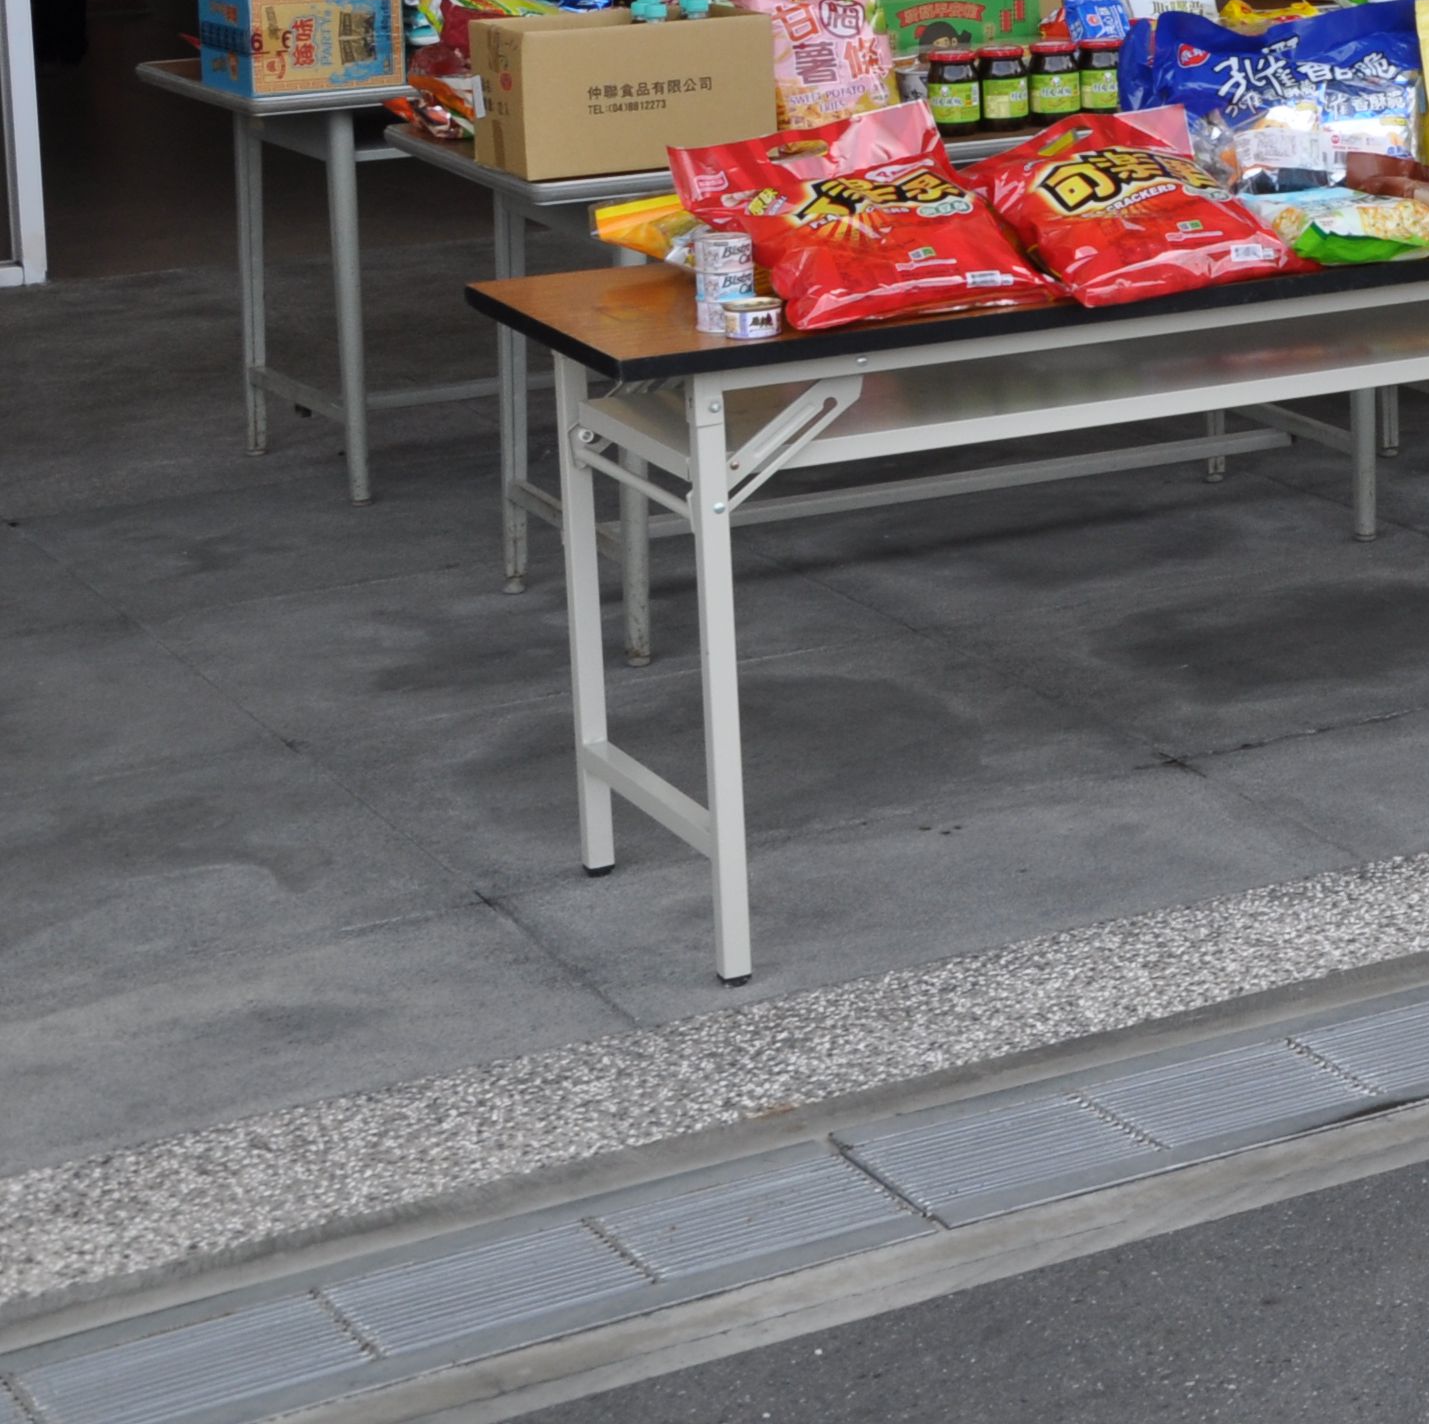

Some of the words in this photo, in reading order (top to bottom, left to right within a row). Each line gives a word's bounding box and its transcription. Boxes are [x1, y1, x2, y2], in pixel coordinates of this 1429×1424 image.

[587, 77, 713, 101] 仲聯食品有限公司
[826, 84, 865, 99] POTATO
